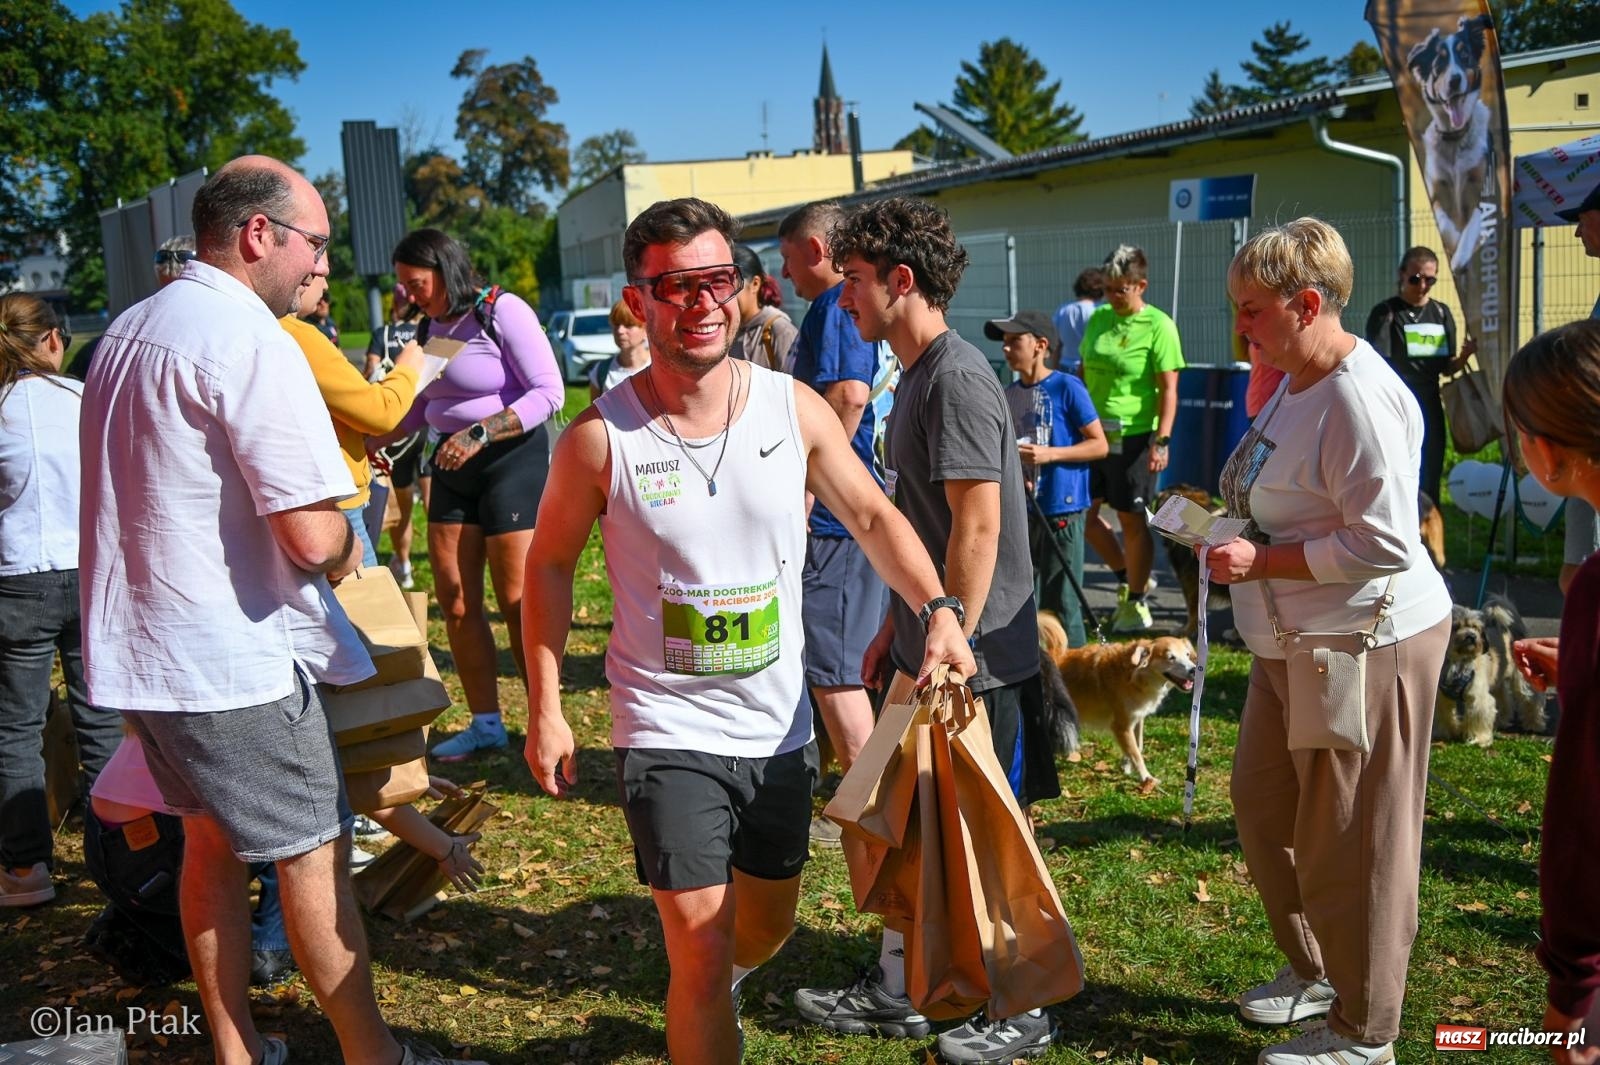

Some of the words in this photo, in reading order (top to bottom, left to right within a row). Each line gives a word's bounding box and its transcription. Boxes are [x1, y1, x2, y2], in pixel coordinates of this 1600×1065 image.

[1479, 201, 1499, 333] EUPHORIA
[635, 459, 681, 476] MATEUSZ
[663, 587, 710, 598] ZOO-MAR
[712, 593, 762, 607] RACIBÓRZ
[705, 612, 749, 643] 81
